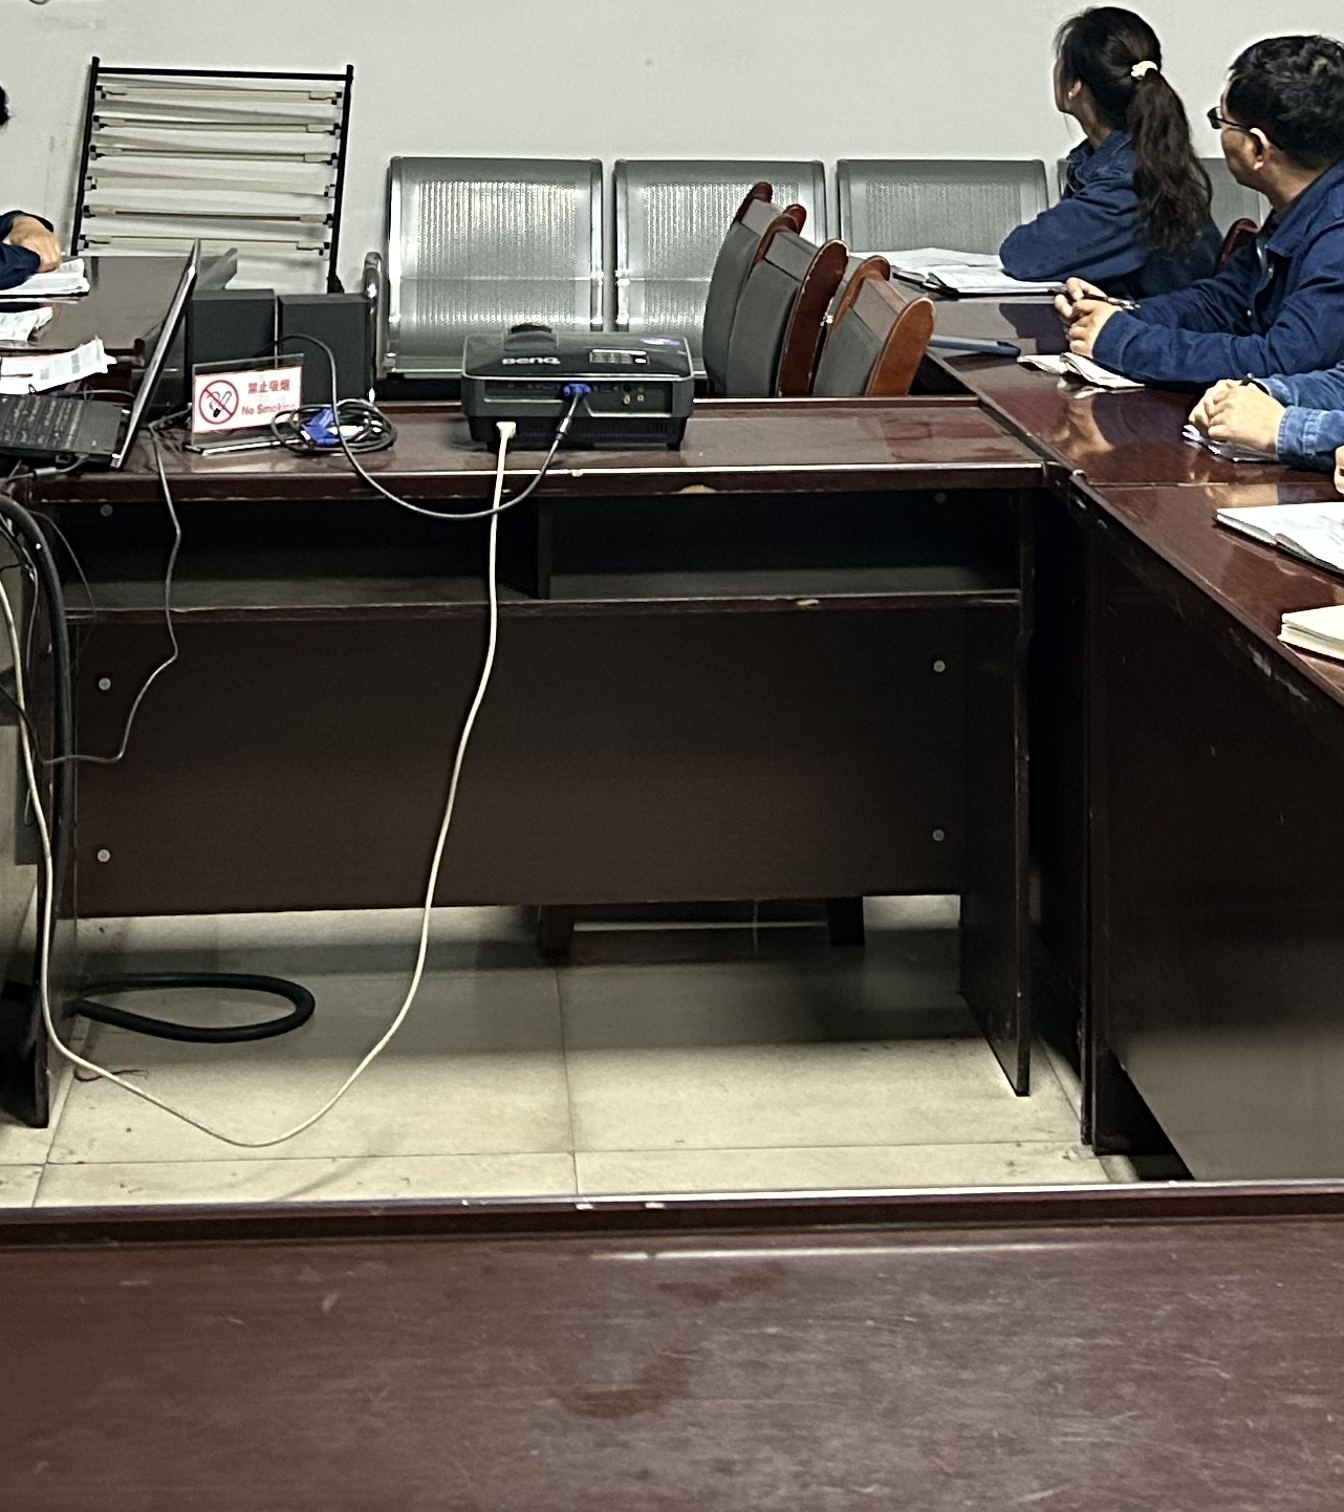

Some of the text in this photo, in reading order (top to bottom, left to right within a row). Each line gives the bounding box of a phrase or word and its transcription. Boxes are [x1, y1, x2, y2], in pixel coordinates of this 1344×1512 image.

[248, 379, 290, 394] 禁止吸烟
[241, 405, 255, 416] No
